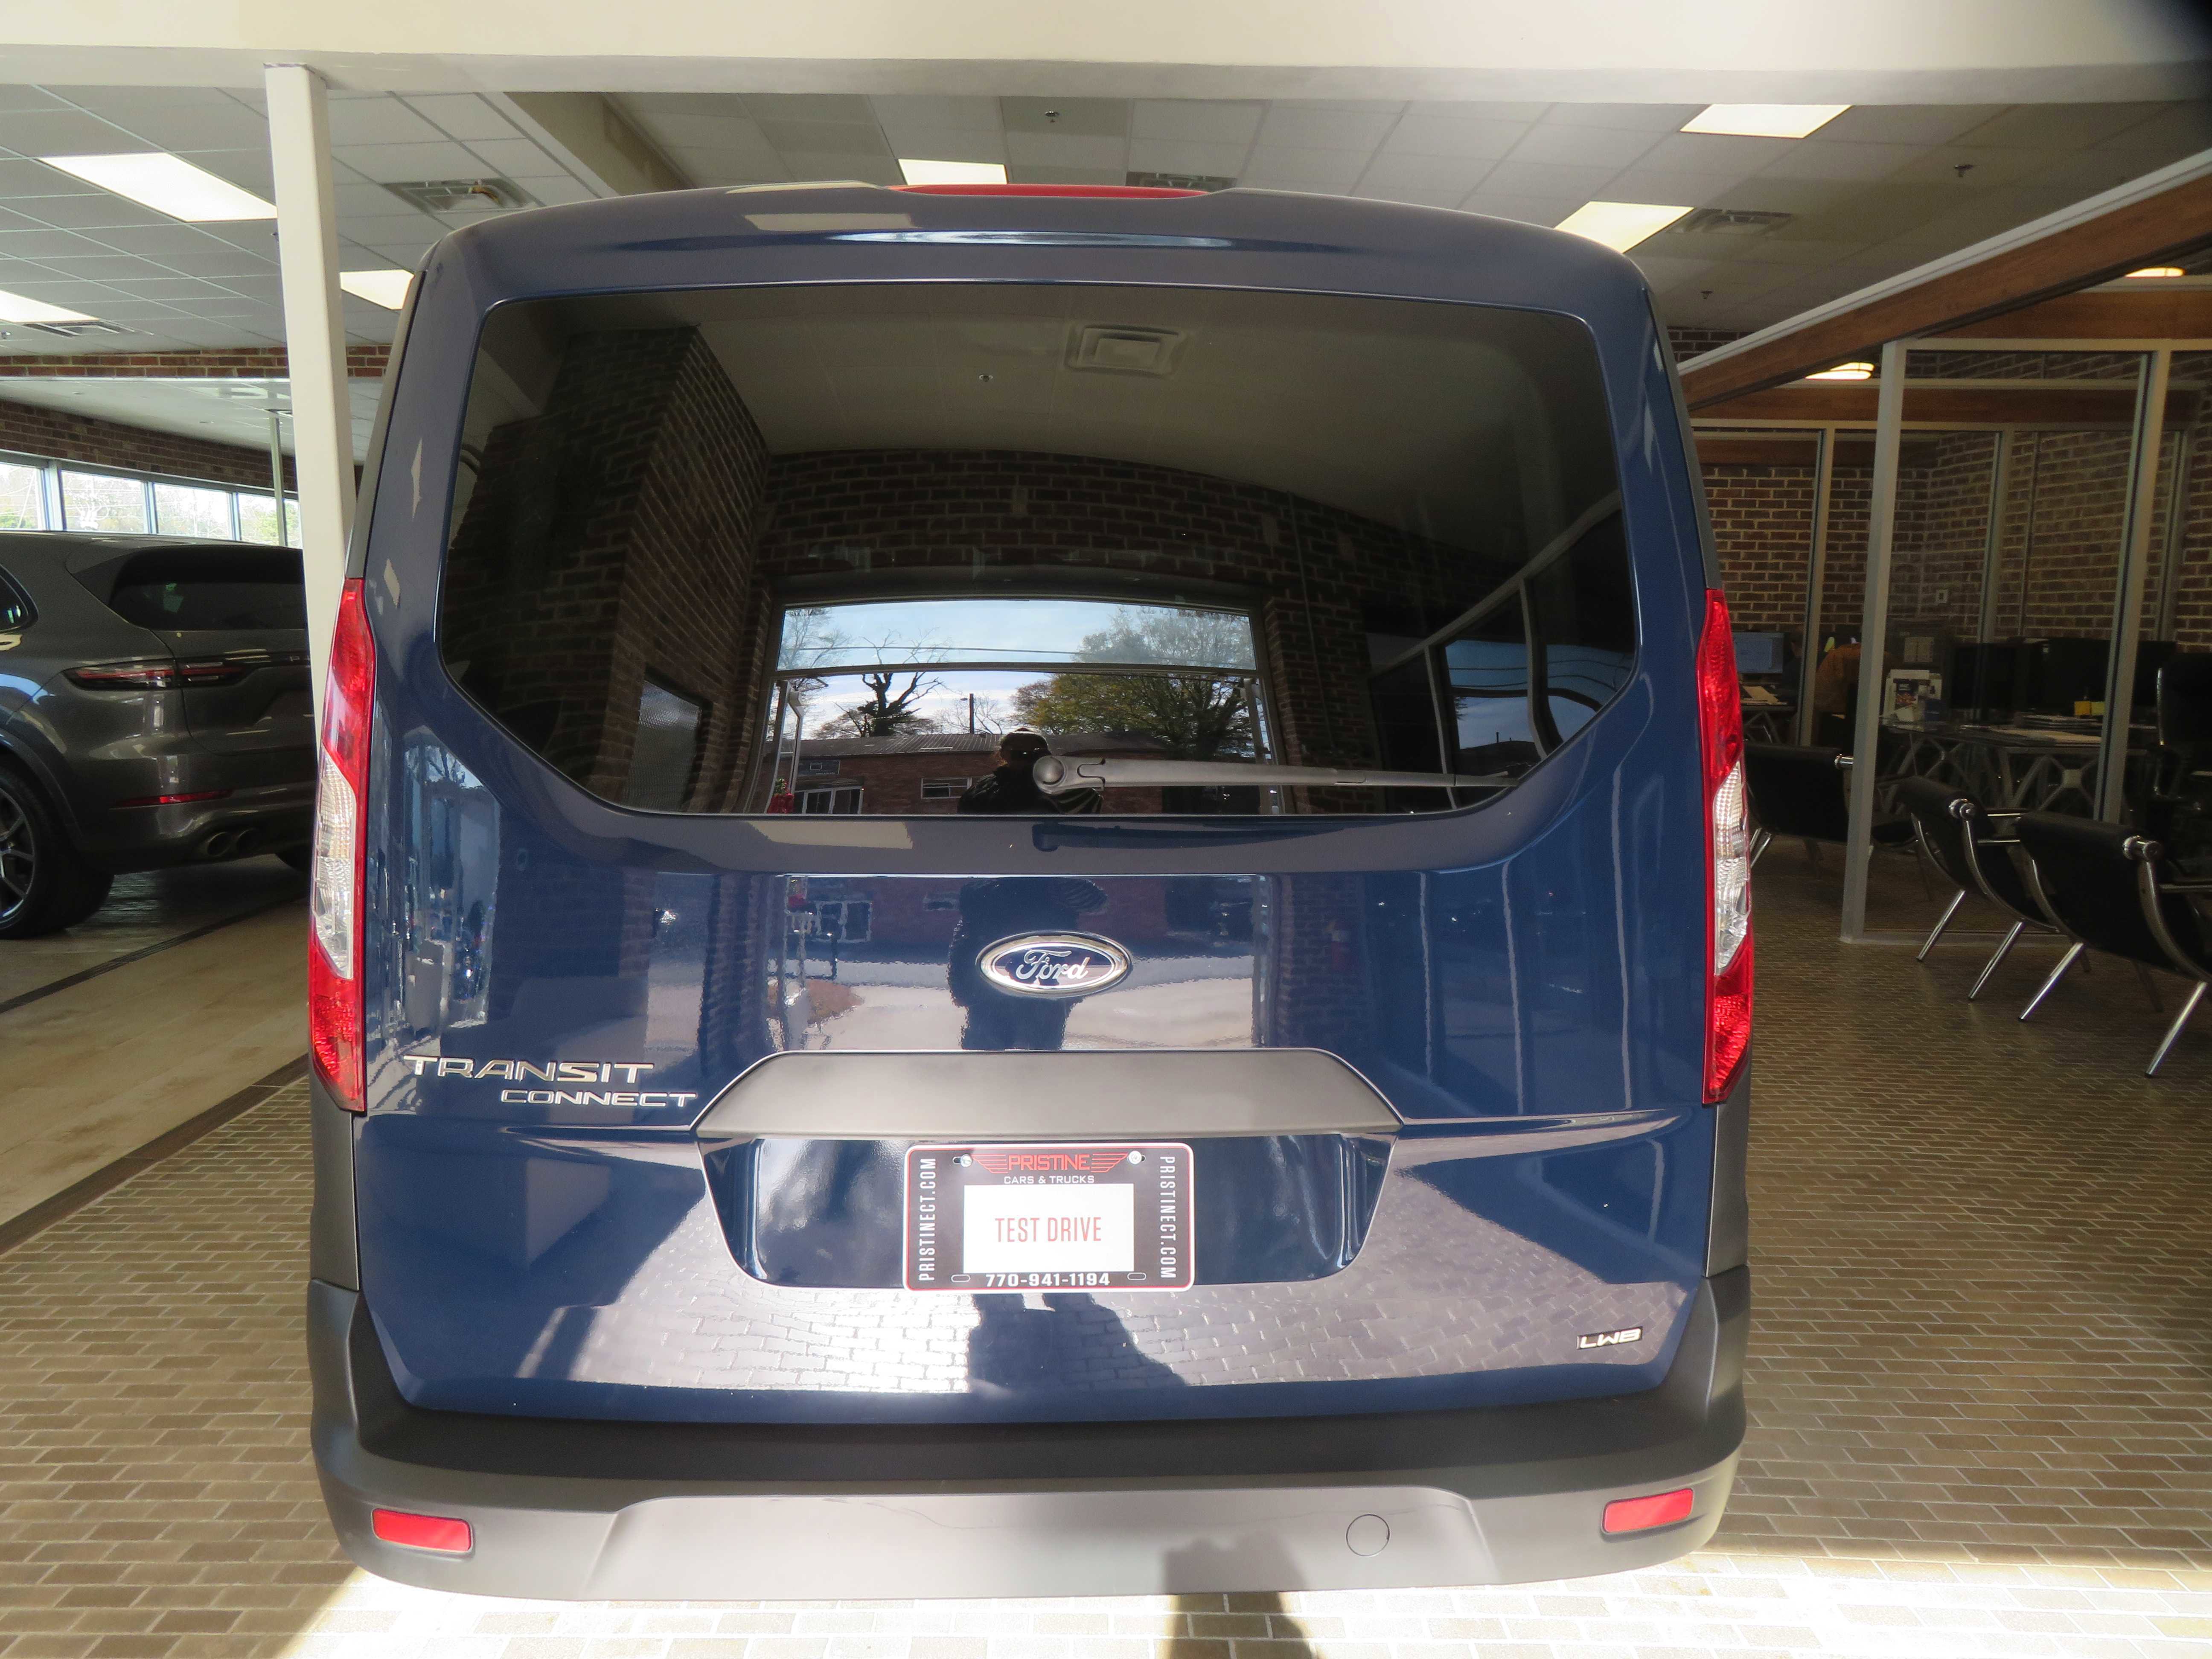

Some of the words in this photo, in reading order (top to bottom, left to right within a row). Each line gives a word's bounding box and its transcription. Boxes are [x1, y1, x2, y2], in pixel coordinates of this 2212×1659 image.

[1016, 949, 1091, 980] Ford
[403, 1055, 654, 1083] TRANSIT
[501, 1089, 697, 1107] CONNECT
[1008, 1154, 1090, 1171] PRISTINE
[1004, 1176, 1034, 1185] CARS
[1049, 1175, 1095, 1184] TRUCKS
[919, 1158, 936, 1281] PRISTINECT.COM
[1159, 1155, 1177, 1279] PRISTINECT.COM
[995, 1217, 1040, 1243] TEST
[1047, 1217, 1102, 1242] DRIVE
[985, 1272, 1110, 1287] 770-941-1194
[1580, 1327, 1642, 1349] LWB
